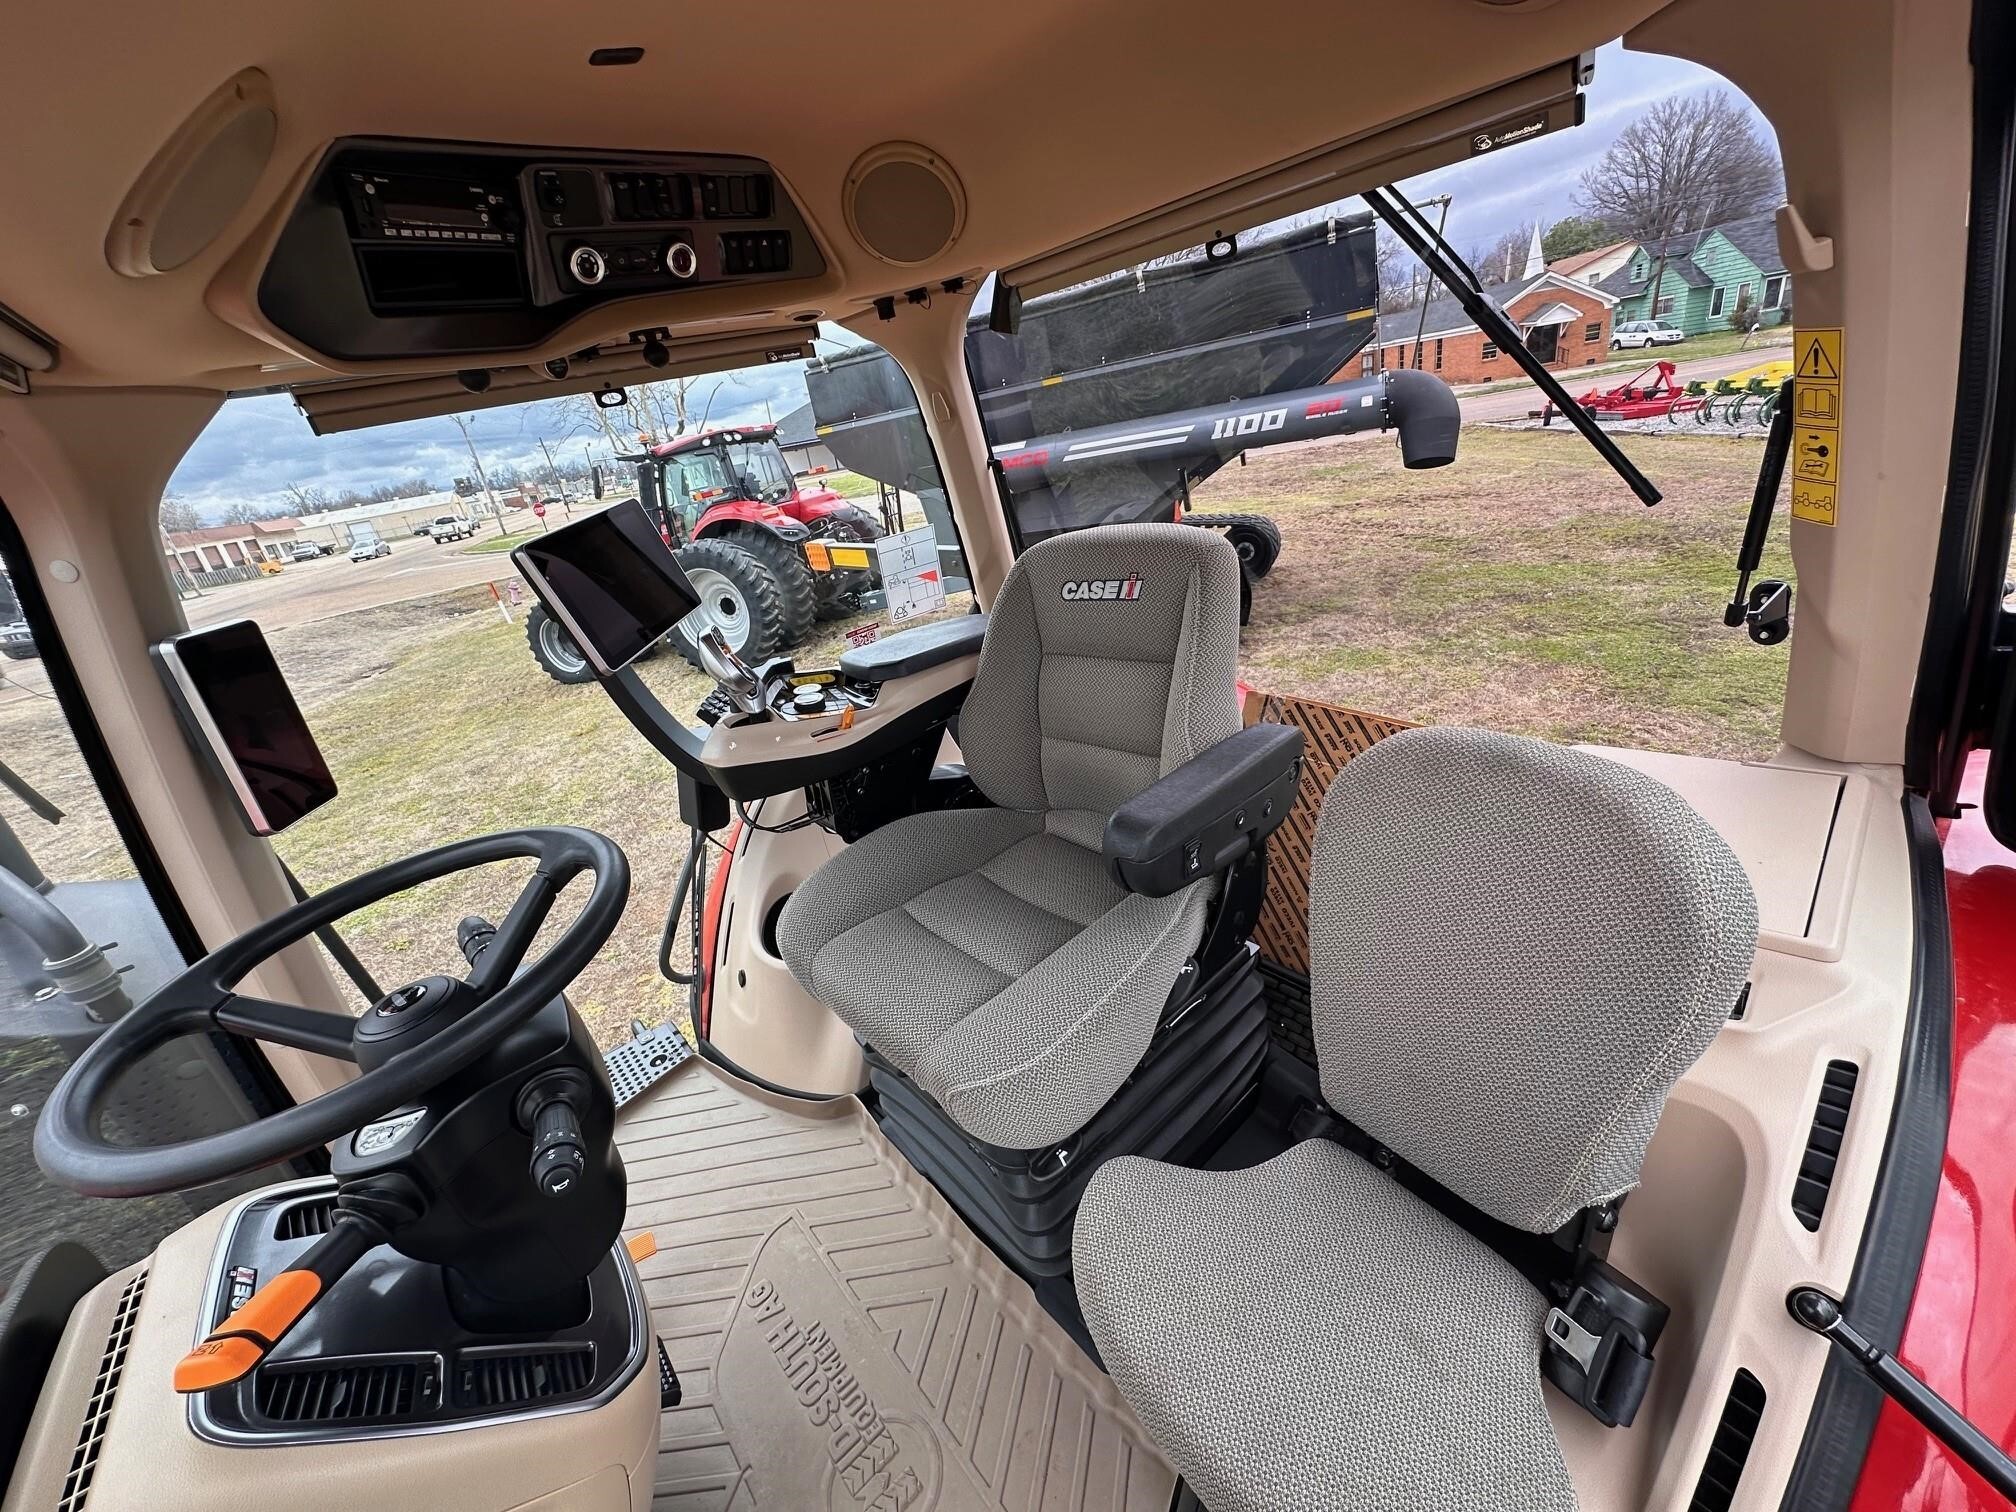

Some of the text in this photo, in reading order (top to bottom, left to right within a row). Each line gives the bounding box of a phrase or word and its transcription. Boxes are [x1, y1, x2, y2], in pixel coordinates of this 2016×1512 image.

[1211, 408, 1289, 440] 1100
[1061, 581, 1120, 600] CASE
[1281, 907, 1296, 928] IVECO
[745, 1279, 786, 1325] AG
[804, 1320, 888, 1445] EQUIPMENT
